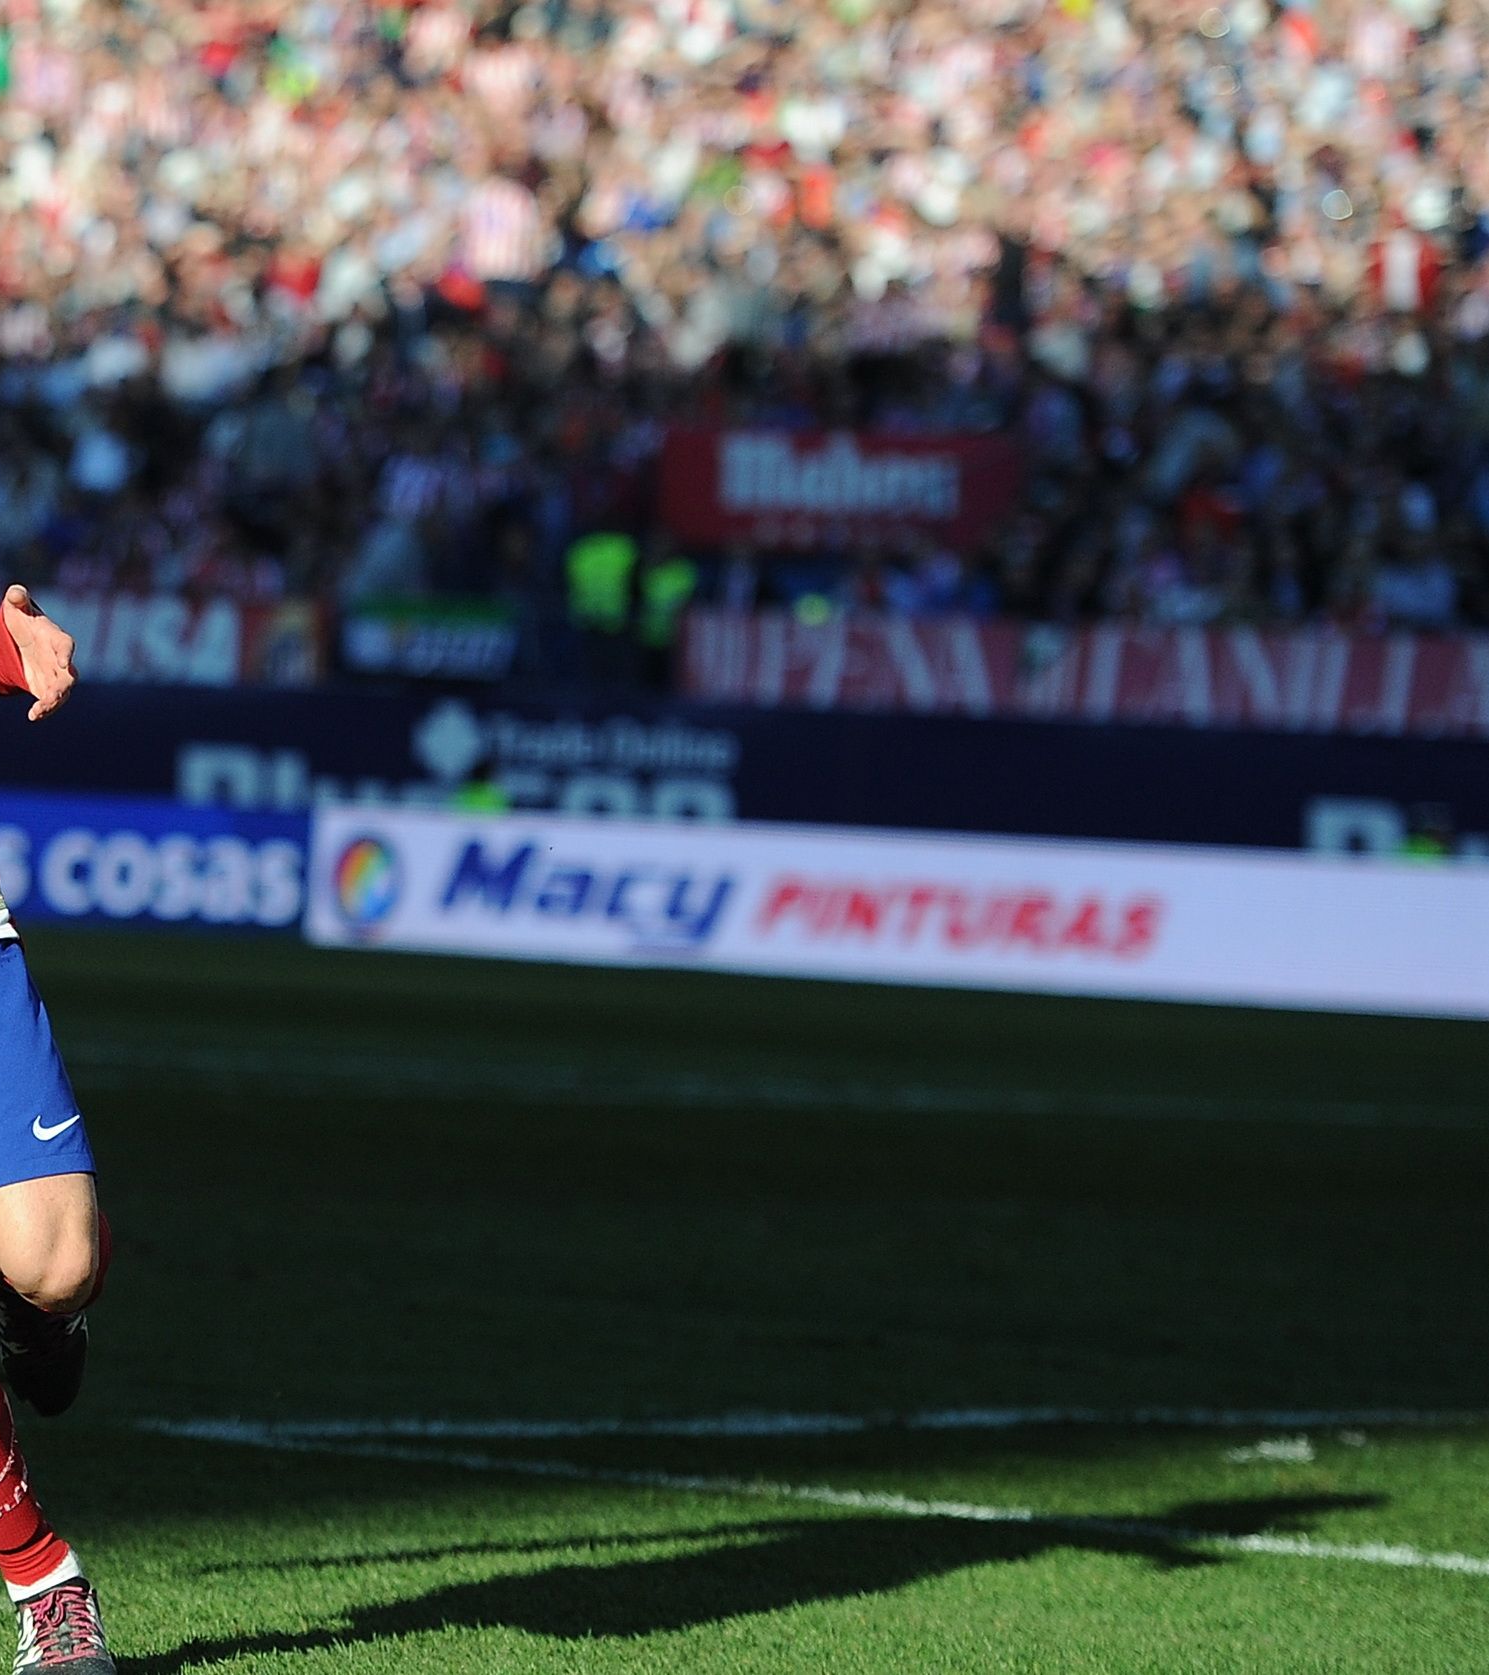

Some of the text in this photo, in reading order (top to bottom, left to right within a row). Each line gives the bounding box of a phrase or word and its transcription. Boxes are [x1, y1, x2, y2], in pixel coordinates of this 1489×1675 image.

[40, 828, 305, 928] cosas
[438, 837, 1164, 960] Macy PINTURAS
